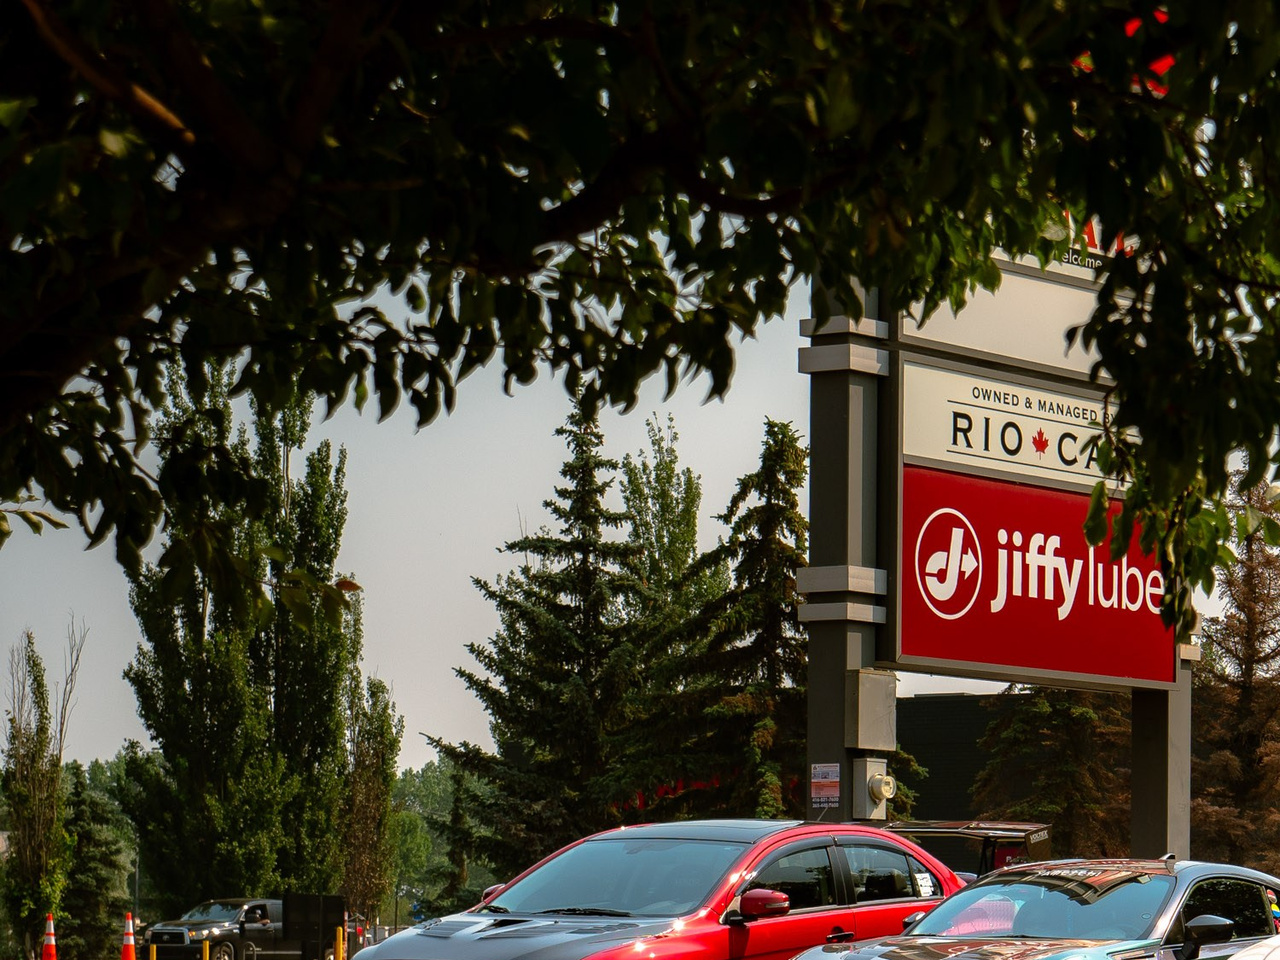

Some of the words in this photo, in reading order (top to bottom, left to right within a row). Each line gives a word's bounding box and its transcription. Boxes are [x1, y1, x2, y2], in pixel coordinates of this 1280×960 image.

[1062, 249, 1103, 269] elcome
[972, 386, 1019, 407] OWNED
[1024, 396, 1034, 410] &
[1038, 399, 1098, 422] MANAGED
[951, 410, 1023, 457] RIO
